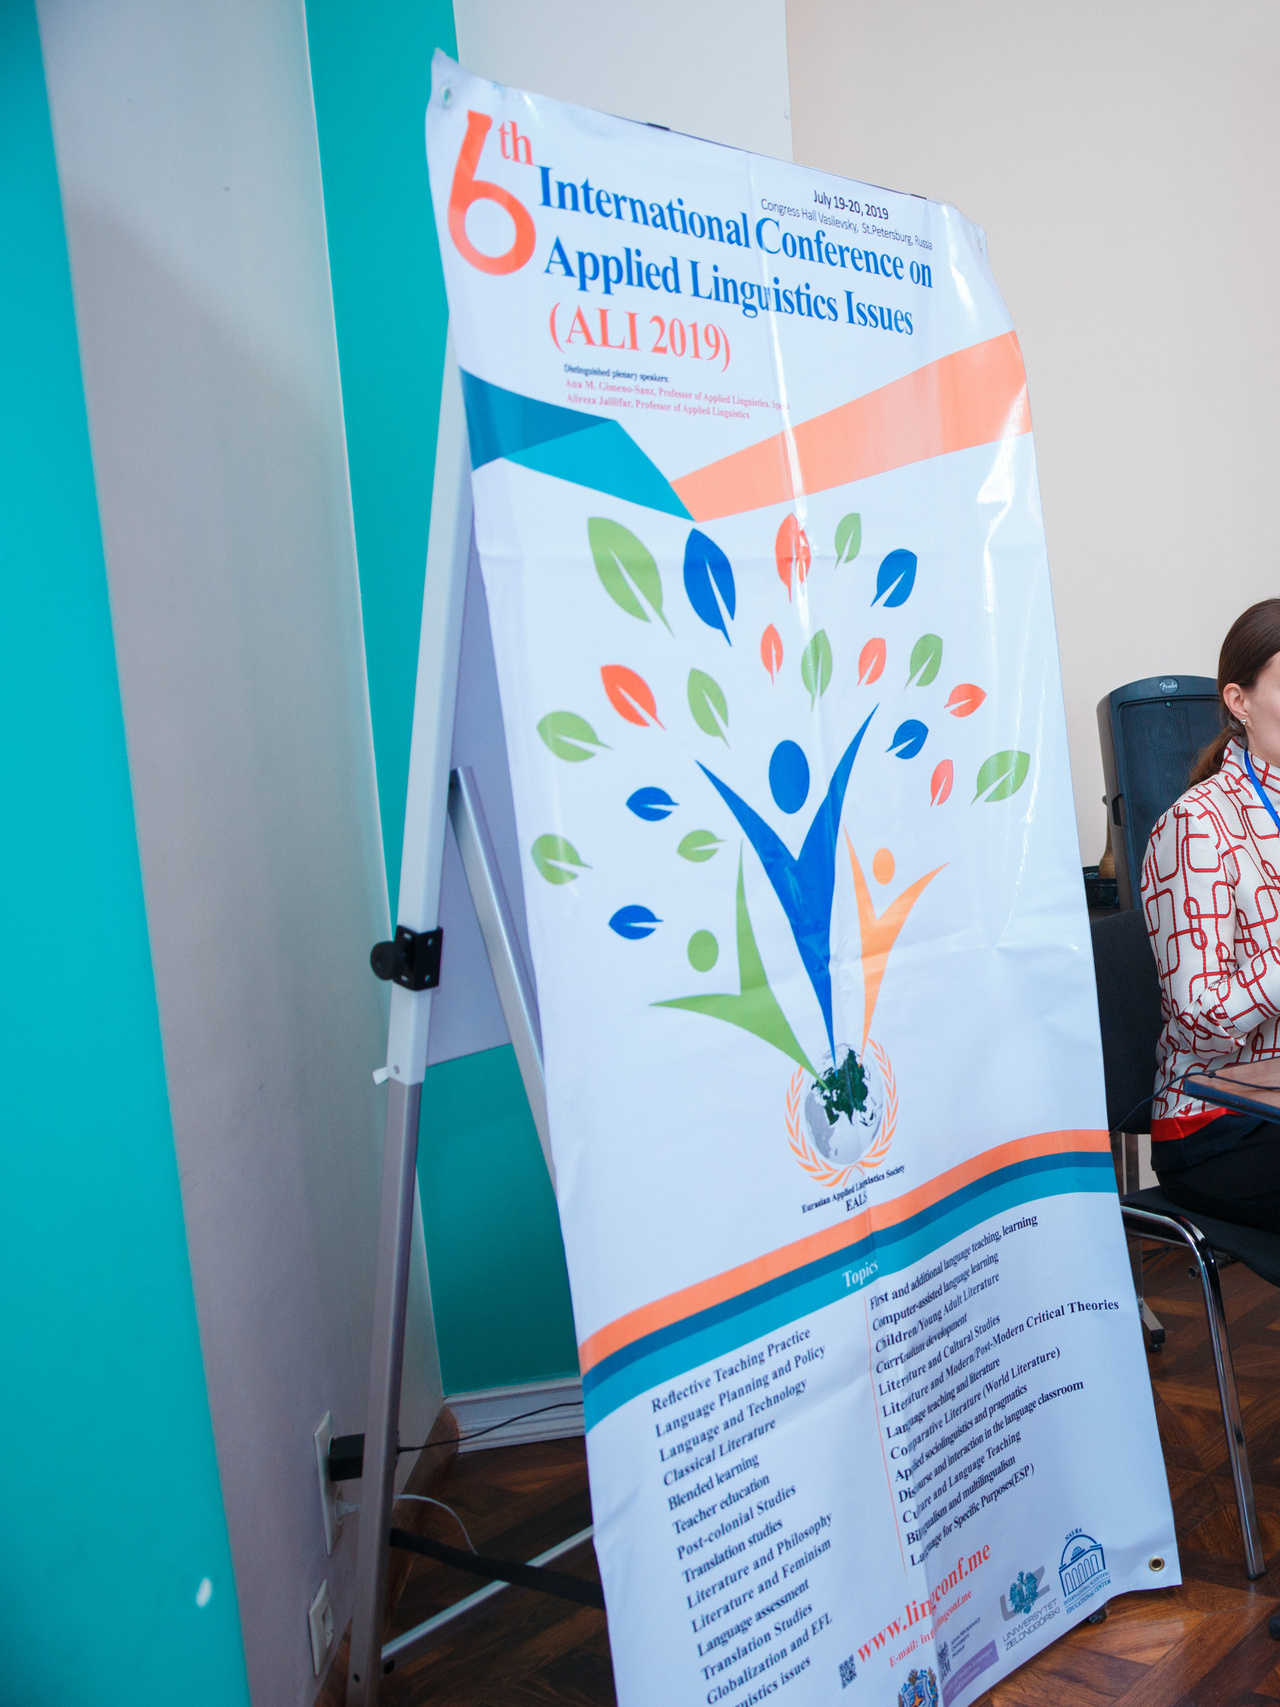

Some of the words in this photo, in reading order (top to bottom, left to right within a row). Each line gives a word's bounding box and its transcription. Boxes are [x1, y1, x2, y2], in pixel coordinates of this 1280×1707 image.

[536, 164, 752, 249] International
[756, 217, 904, 280] Conference
[909, 260, 933, 288] on
[761, 198, 800, 218] Congress
[802, 208, 817, 223] Hall
[818, 212, 858, 234] Vasilevsky,
[915, 235, 933, 250] Russia
[813, 190, 832, 210] July
[834, 196, 864, 217] 19-20,
[865, 203, 889, 220] 2019
[544, 235, 682, 295] Applied
[687, 257, 839, 323] Linguistics
[843, 290, 913, 335] Issues
[549, 302, 642, 353] (ALI
[649, 315, 731, 373] 2019)
[566, 379, 582, 388] Ana
[659, 388, 692, 399] Professor
[704, 393, 730, 404] Applied
[635, 399, 671, 412] Professor
[674, 403, 681, 412] of
[683, 405, 710, 415] Applied
[713, 407, 749, 419] Linguistics
[842, 1260, 878, 1287] Topics
[870, 1291, 888, 1310] First
[891, 1283, 910, 1300] and
[911, 1262, 943, 1291] additional
[943, 1247, 971, 1270] language
[1002, 1215, 1038, 1236] learning
[873, 1284, 943, 1331] Computer-assisted
[943, 1267, 970, 1293] language
[971, 1252, 999, 1275] learning
[943, 1296, 963, 1316] Adult
[963, 1273, 1000, 1301] Literature
[879, 1364, 926, 1396] Literature
[928, 1351, 942, 1369] and
[943, 1330, 974, 1358] Cultural
[974, 1315, 1000, 1337] Studies
[882, 1385, 929, 1418] Literature
[930, 1372, 944, 1394] and
[1026, 1305, 1065, 1328] Critical
[1067, 1299, 1119, 1313] Theories
[926, 1313, 967, 1347] development
[651, 1377, 711, 1413] Reflective
[713, 1351, 765, 1382] Teaching
[767, 1328, 810, 1357] Practice
[655, 1401, 716, 1438] Language
[718, 1374, 770, 1406] Planning
[772, 1360, 792, 1380] and
[794, 1345, 826, 1368] Policy
[927, 1389, 955, 1414] teaching
[956, 1380, 969, 1398] and
[969, 1358, 1000, 1385] literature
[944, 1391, 982, 1424] Literature
[982, 1372, 1010, 1398] (World
[1011, 1347, 1060, 1379] Literature)
[659, 1425, 720, 1462] Language
[723, 1410, 744, 1431] and
[746, 1379, 807, 1417] Technology
[663, 1449, 716, 1486] Classical
[719, 1418, 776, 1457] Literature
[925, 1420, 974, 1459] sociolinguistics
[974, 1407, 987, 1425] and
[988, 1384, 1028, 1418] pragmatics
[934, 1461, 947, 1476] and
[948, 1432, 984, 1466] interaction
[993, 1420, 1004, 1434] the
[1004, 1400, 1037, 1425] language
[1038, 1381, 1084, 1406] classroom
[667, 1476, 714, 1511] Blended
[715, 1454, 760, 1485] learning
[933, 1485, 947, 1500] and
[948, 1455, 985, 1488] Language
[986, 1430, 1021, 1459] Teaching
[948, 1492, 962, 1511] and
[962, 1456, 1016, 1500] multilingualism
[672, 1502, 718, 1535] Teacher
[720, 1475, 770, 1510] education
[676, 1508, 754, 1560] Post-colonial
[757, 1484, 796, 1515] Studies
[942, 1523, 953, 1538] for
[954, 1502, 980, 1528] Specific
[682, 1541, 746, 1583] Translation
[748, 1519, 783, 1547] studies
[686, 1566, 750, 1609] Literature
[752, 1548, 774, 1570] and
[776, 1512, 832, 1555] Philosophy
[691, 1588, 754, 1633] Literature
[757, 1571, 779, 1594] and
[781, 1539, 831, 1578] Feminism
[696, 1616, 753, 1657] Language
[755, 1579, 809, 1621] assessment
[857, 1544, 990, 1663] www.lingconf.me
[1002, 1598, 1057, 1642] UNIWERSYTET
[701, 1632, 772, 1681] Translation
[774, 1603, 813, 1636] Studies
[706, 1647, 788, 1705] Globalization
[790, 1629, 809, 1652] and
[811, 1612, 833, 1635] EFL
[780, 1656, 811, 1685] issues
[889, 1640, 919, 1668] E-mail:
